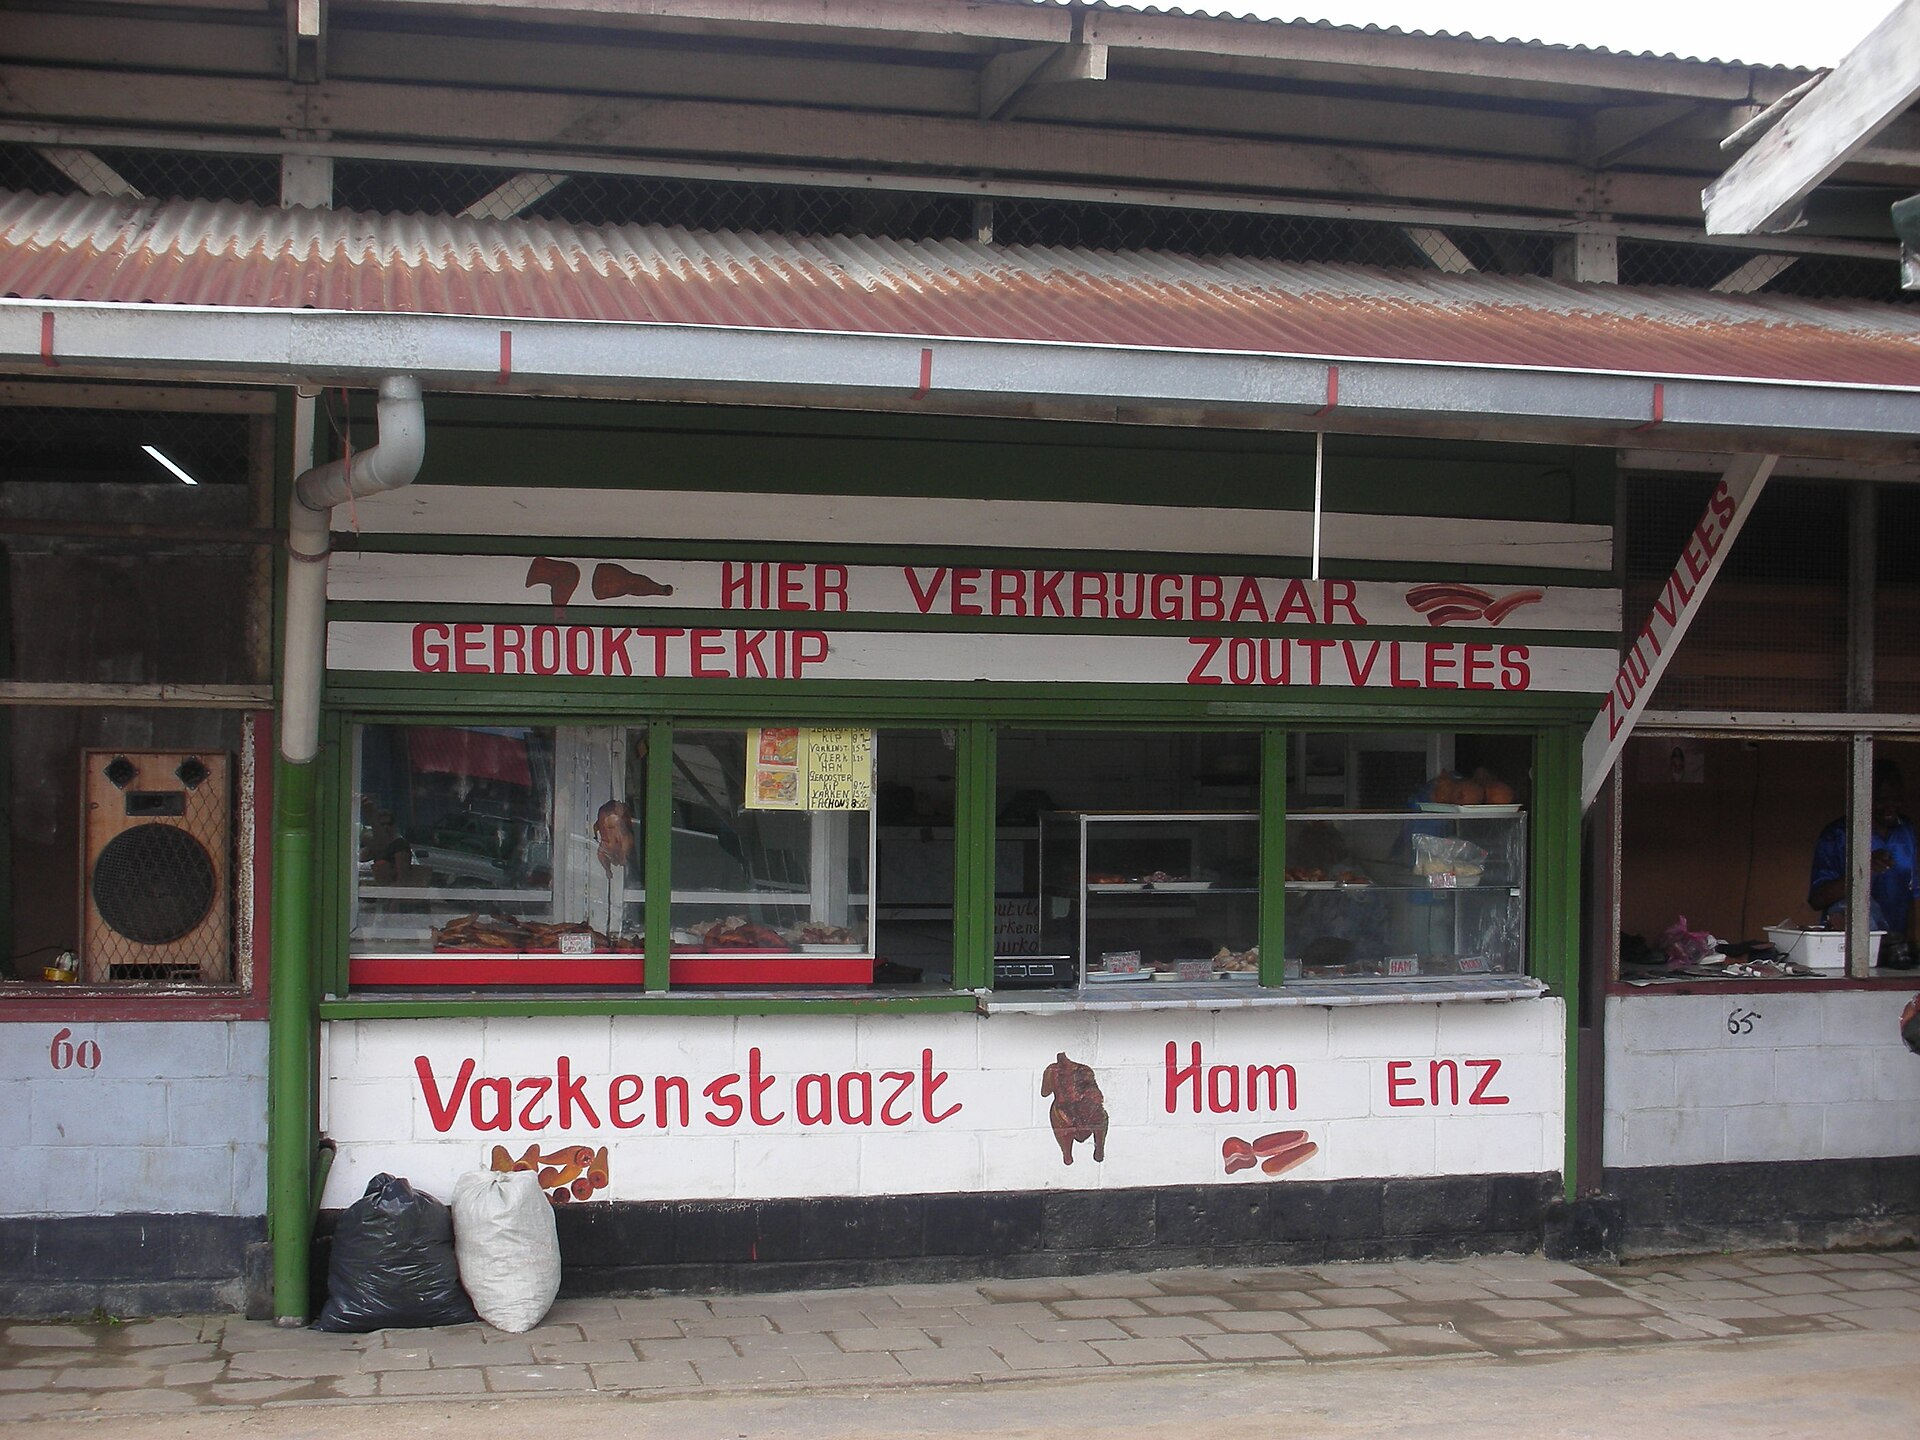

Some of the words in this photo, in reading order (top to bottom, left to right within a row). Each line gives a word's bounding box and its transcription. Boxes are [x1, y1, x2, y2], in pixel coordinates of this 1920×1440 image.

[720, 560, 849, 612] HIER
[1600, 480, 1736, 742] ZOUTVLEES
[1187, 636, 1531, 691] ZOUTVLEES
[1727, 1007, 1762, 1035] 65
[50, 1027, 102, 1070] 60
[1165, 1040, 1297, 1114] Ham
